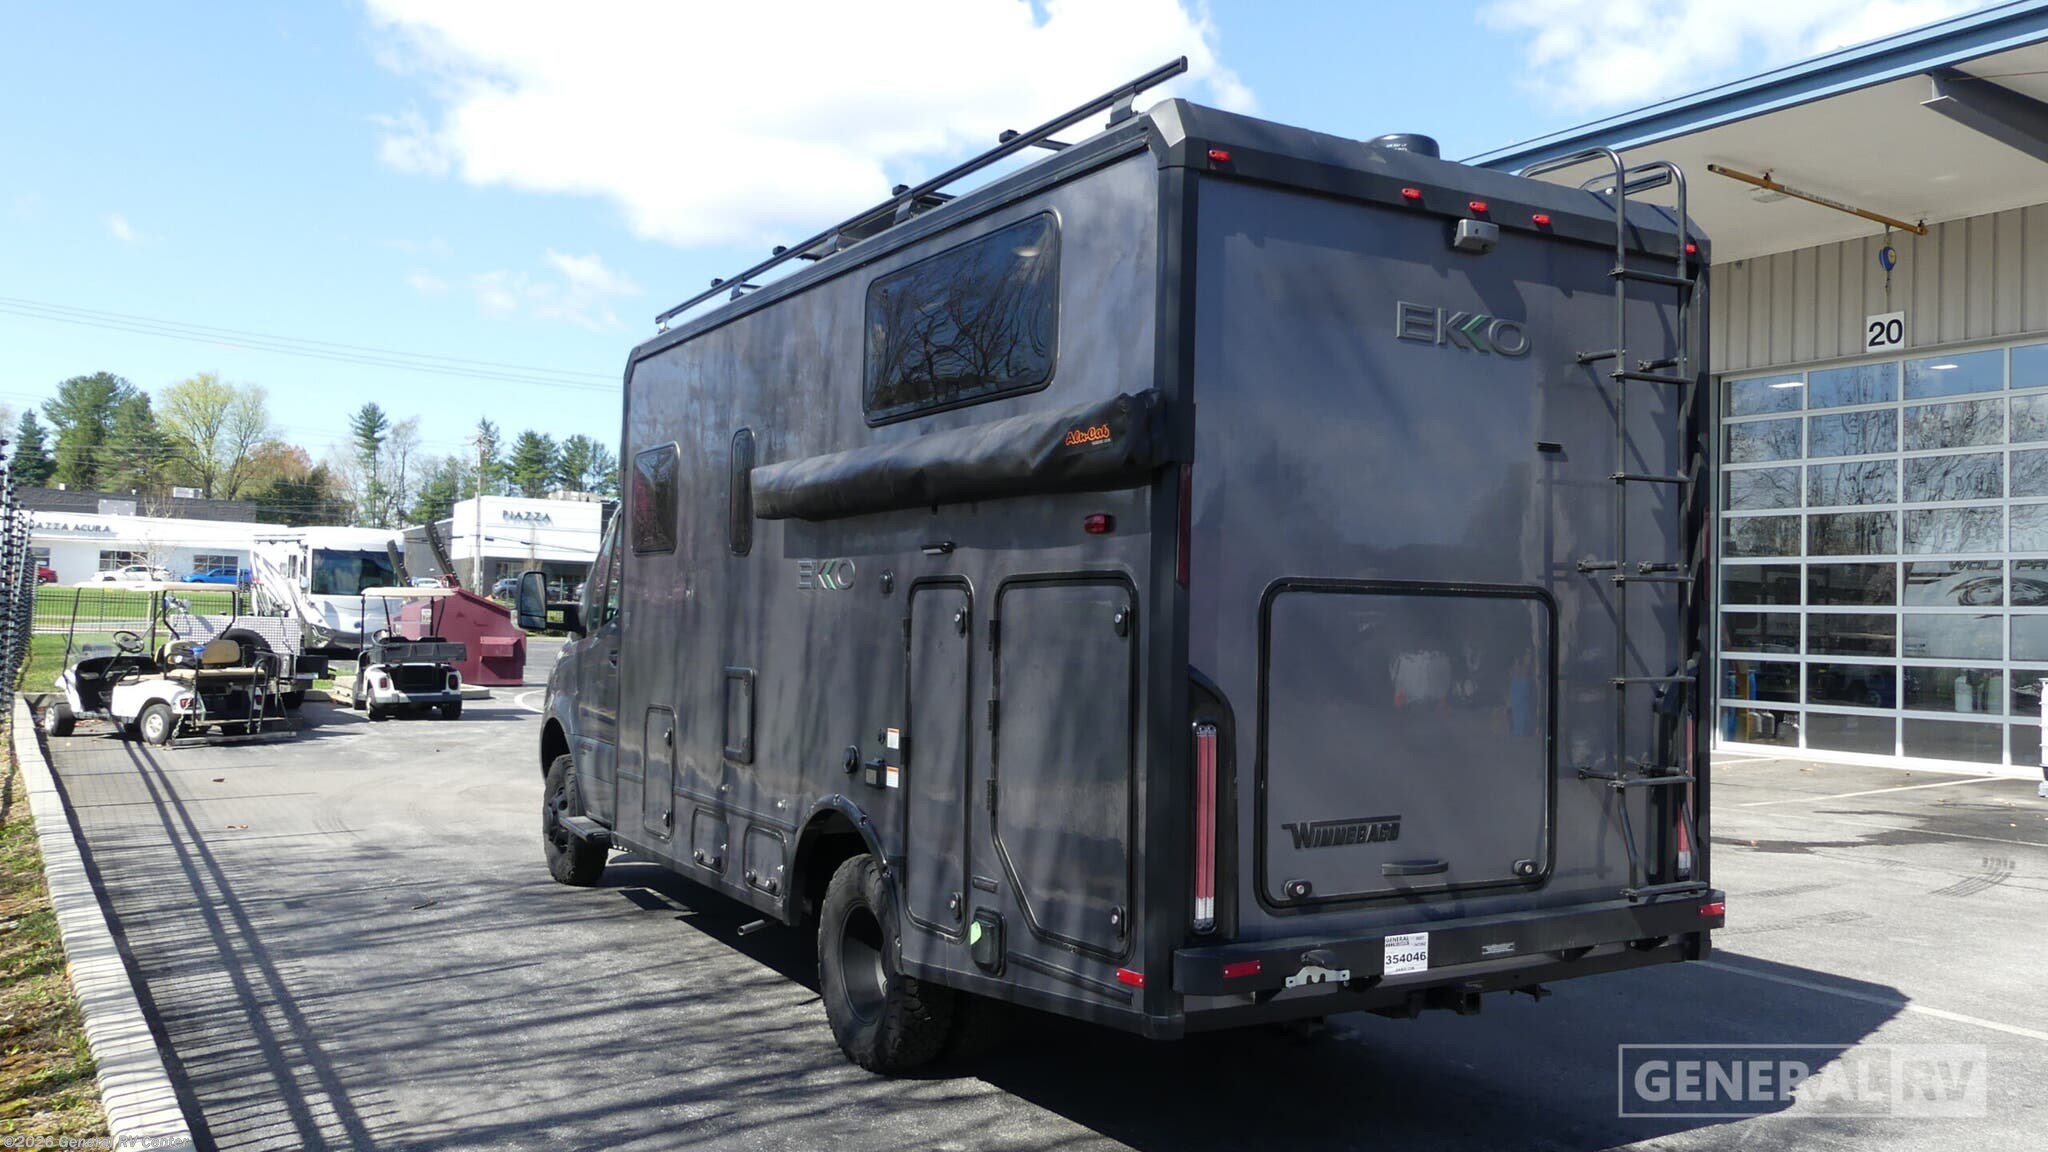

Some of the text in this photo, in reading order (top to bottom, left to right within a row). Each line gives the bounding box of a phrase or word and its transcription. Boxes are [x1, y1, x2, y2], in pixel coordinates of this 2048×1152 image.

[1869, 319, 1903, 347] 20
[502, 509, 551, 522] PIAZZA
[73, 524, 111, 533] ACURA
[1385, 951, 1427, 965] 354046
